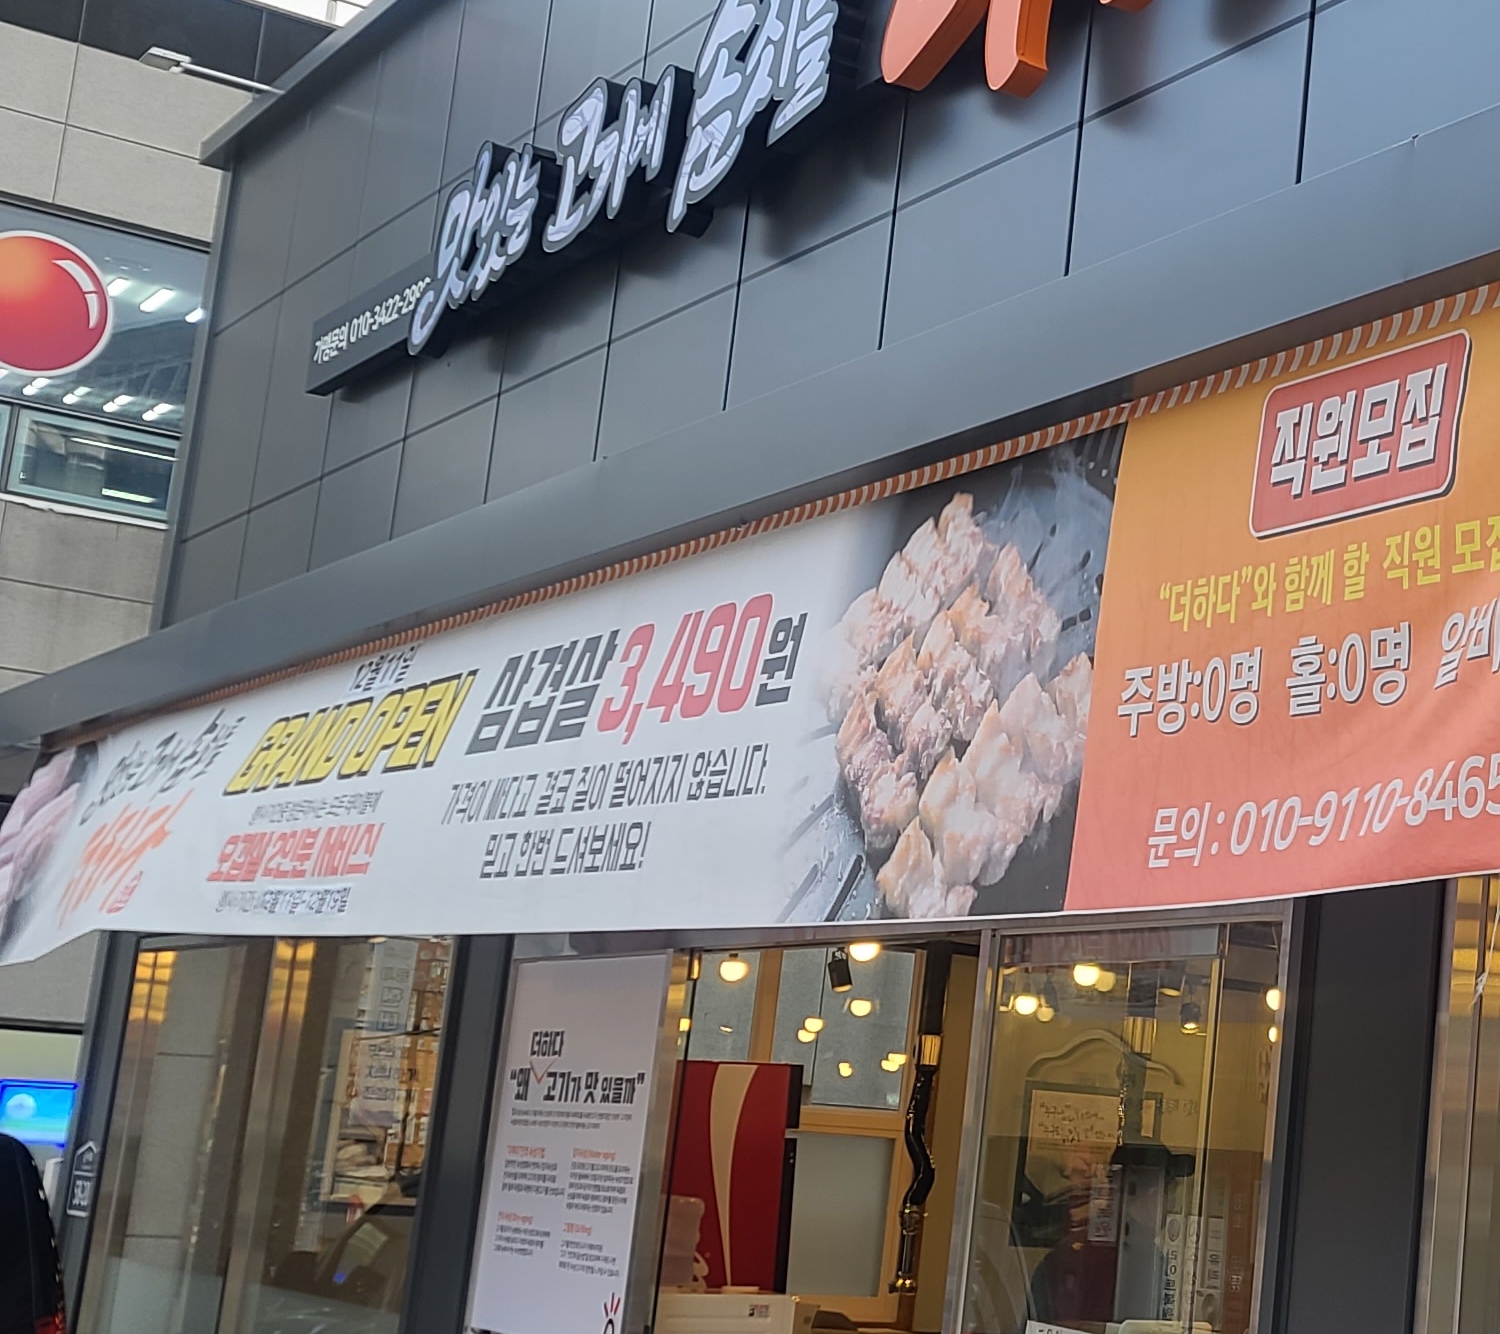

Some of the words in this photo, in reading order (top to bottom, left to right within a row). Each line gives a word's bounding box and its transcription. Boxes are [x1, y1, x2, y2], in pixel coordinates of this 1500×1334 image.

[408, 143, 541, 355] 맛있는
[543, 67, 677, 251] 고기에
[1270, 364, 1446, 496] 직원모집
[1284, 549, 1333, 614] 함께
[1342, 542, 1370, 597] 할
[1382, 523, 1441, 590] 직원
[464, 628, 621, 756] 삼겹살
[596, 592, 809, 745] 3,490원
[1116, 645, 1262, 738] 주방:0명
[1285, 622, 1412, 718] 홀:0명
[223, 696, 373, 796] GRAND
[338, 669, 481, 779] OPEN
[441, 781, 487, 826] 가격이
[483, 773, 537, 822] 싸다고
[534, 768, 575, 816] 결코
[571, 762, 614, 812] 질이
[608, 753, 689, 810] 떨어지지
[686, 743, 769, 801] 않습니다.
[479, 832, 518, 879] 믿고
[514, 827, 551, 877] 한번
[549, 821, 652, 876] 드셔보세요!
[530, 1030, 565, 1057] 더하다
[543, 1071, 582, 1103] 고기가
[583, 1071, 599, 1104] 맛
